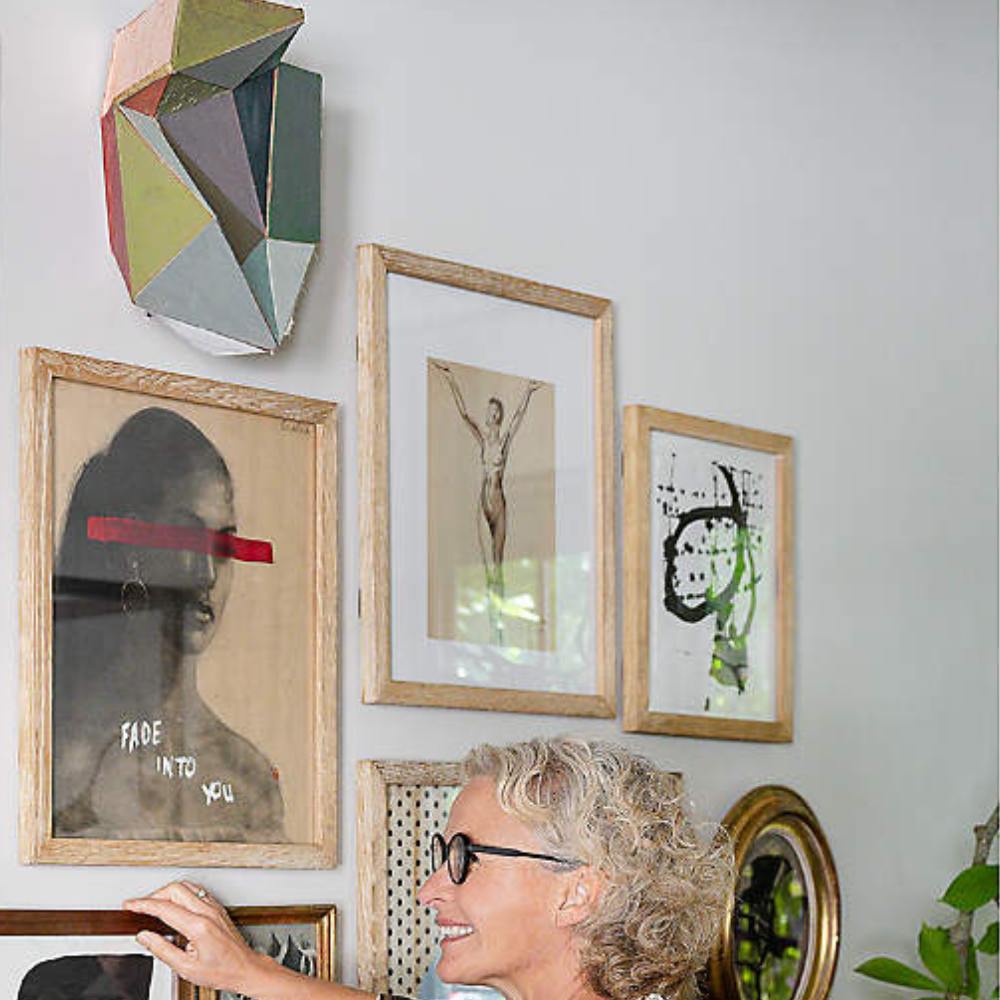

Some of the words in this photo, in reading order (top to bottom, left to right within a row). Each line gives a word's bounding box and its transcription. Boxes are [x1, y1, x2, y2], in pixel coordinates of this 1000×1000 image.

[120, 720, 162, 753] FADE
[156, 756, 196, 779] INTO
[201, 781, 234, 806] YOU
